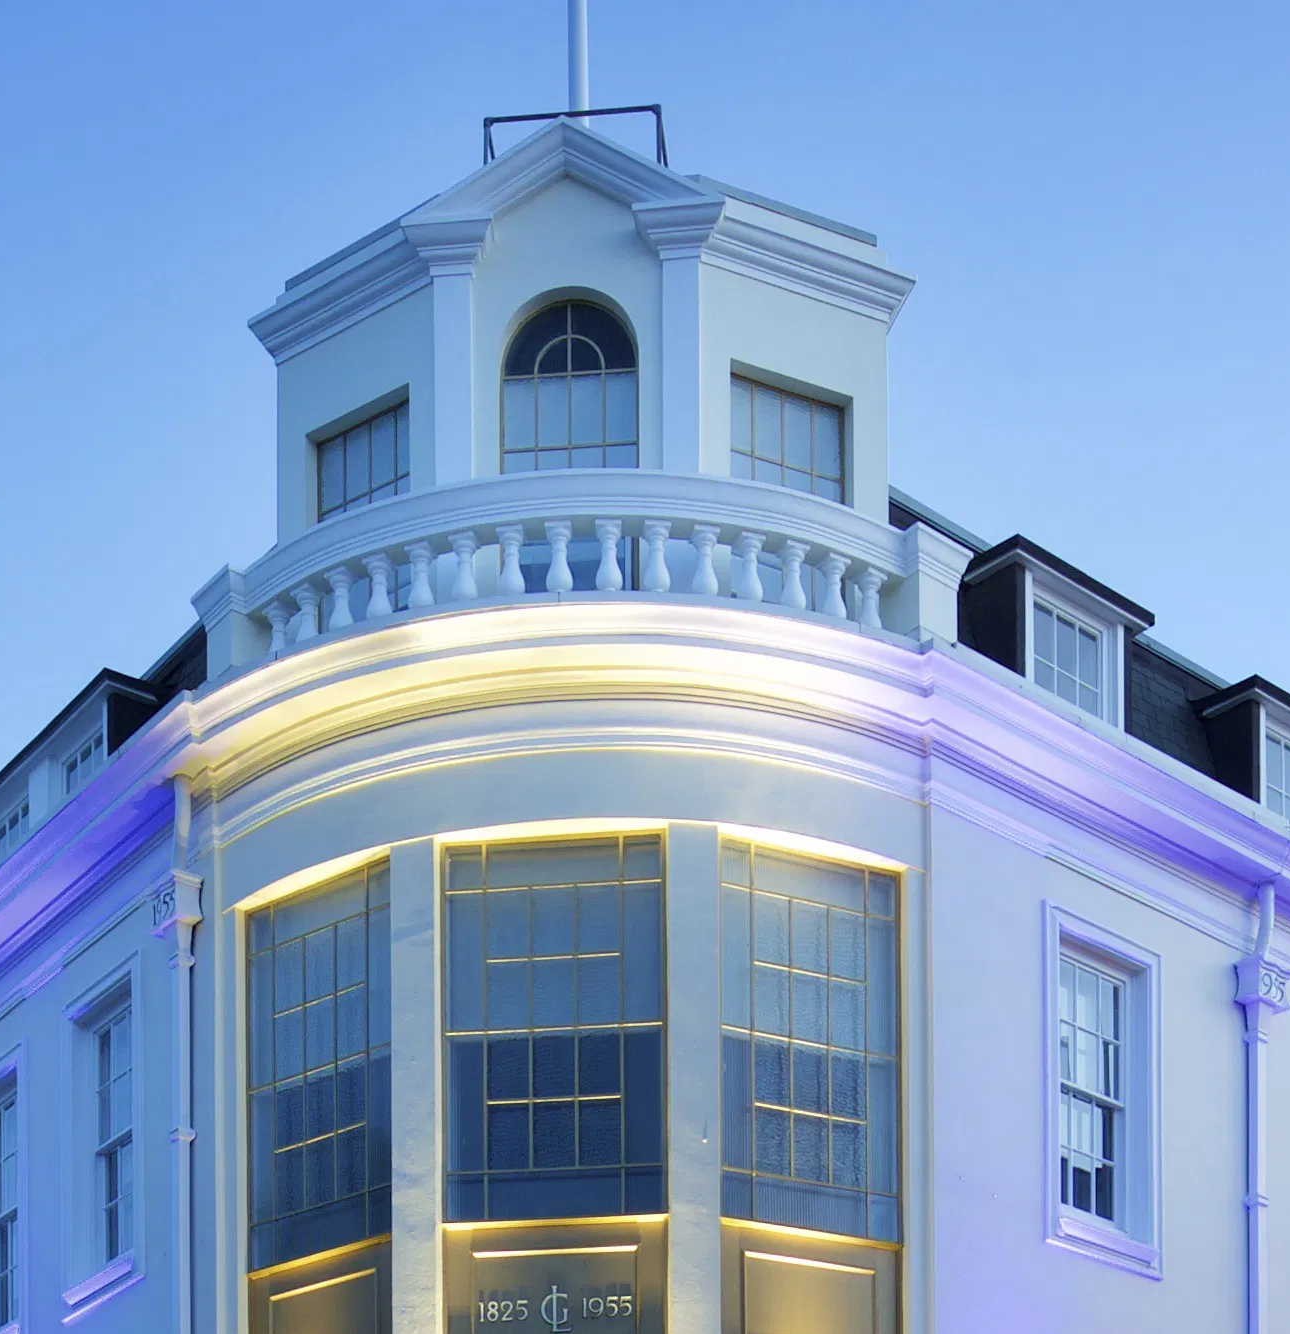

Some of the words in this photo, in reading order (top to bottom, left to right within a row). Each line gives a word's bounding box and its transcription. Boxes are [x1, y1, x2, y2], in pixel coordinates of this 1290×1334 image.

[1261, 972, 1286, 1003] 955
[477, 1299, 529, 1323] 1825
[582, 1295, 633, 1320] 1955
